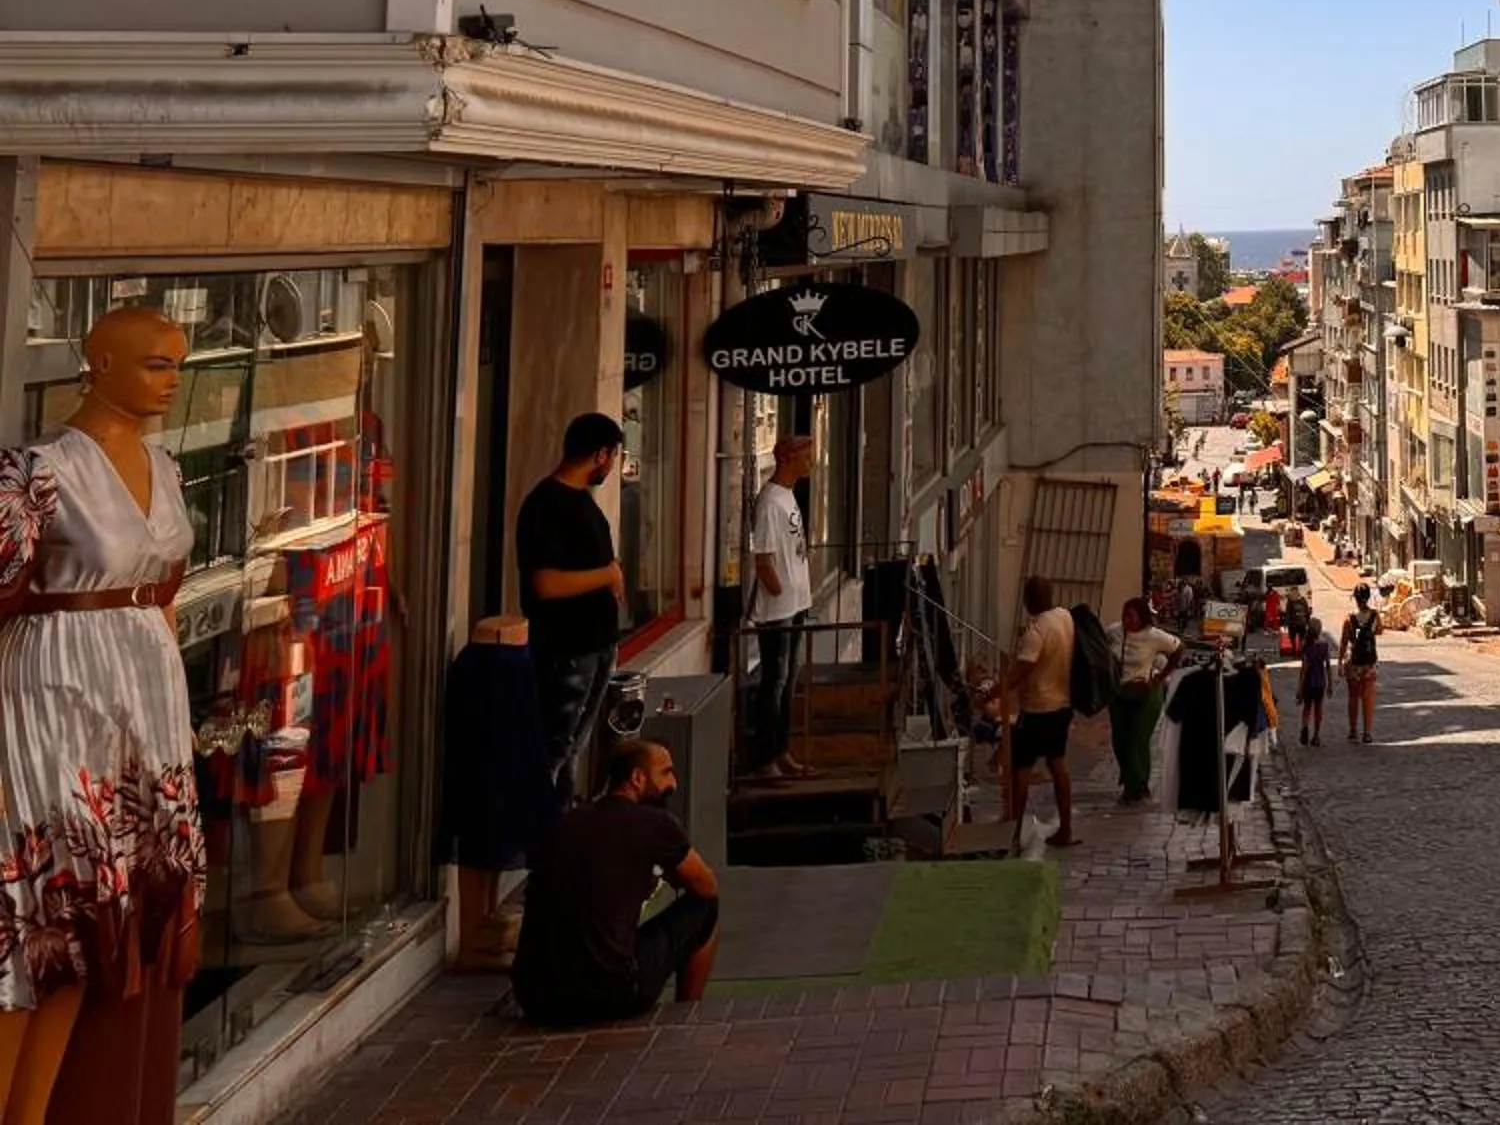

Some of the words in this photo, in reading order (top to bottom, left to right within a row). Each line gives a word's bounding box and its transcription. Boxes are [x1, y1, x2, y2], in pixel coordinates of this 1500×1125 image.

[711, 345, 804, 369] GRAND
[810, 337, 906, 363] KYBELE
[768, 366, 851, 388] HOTEL
